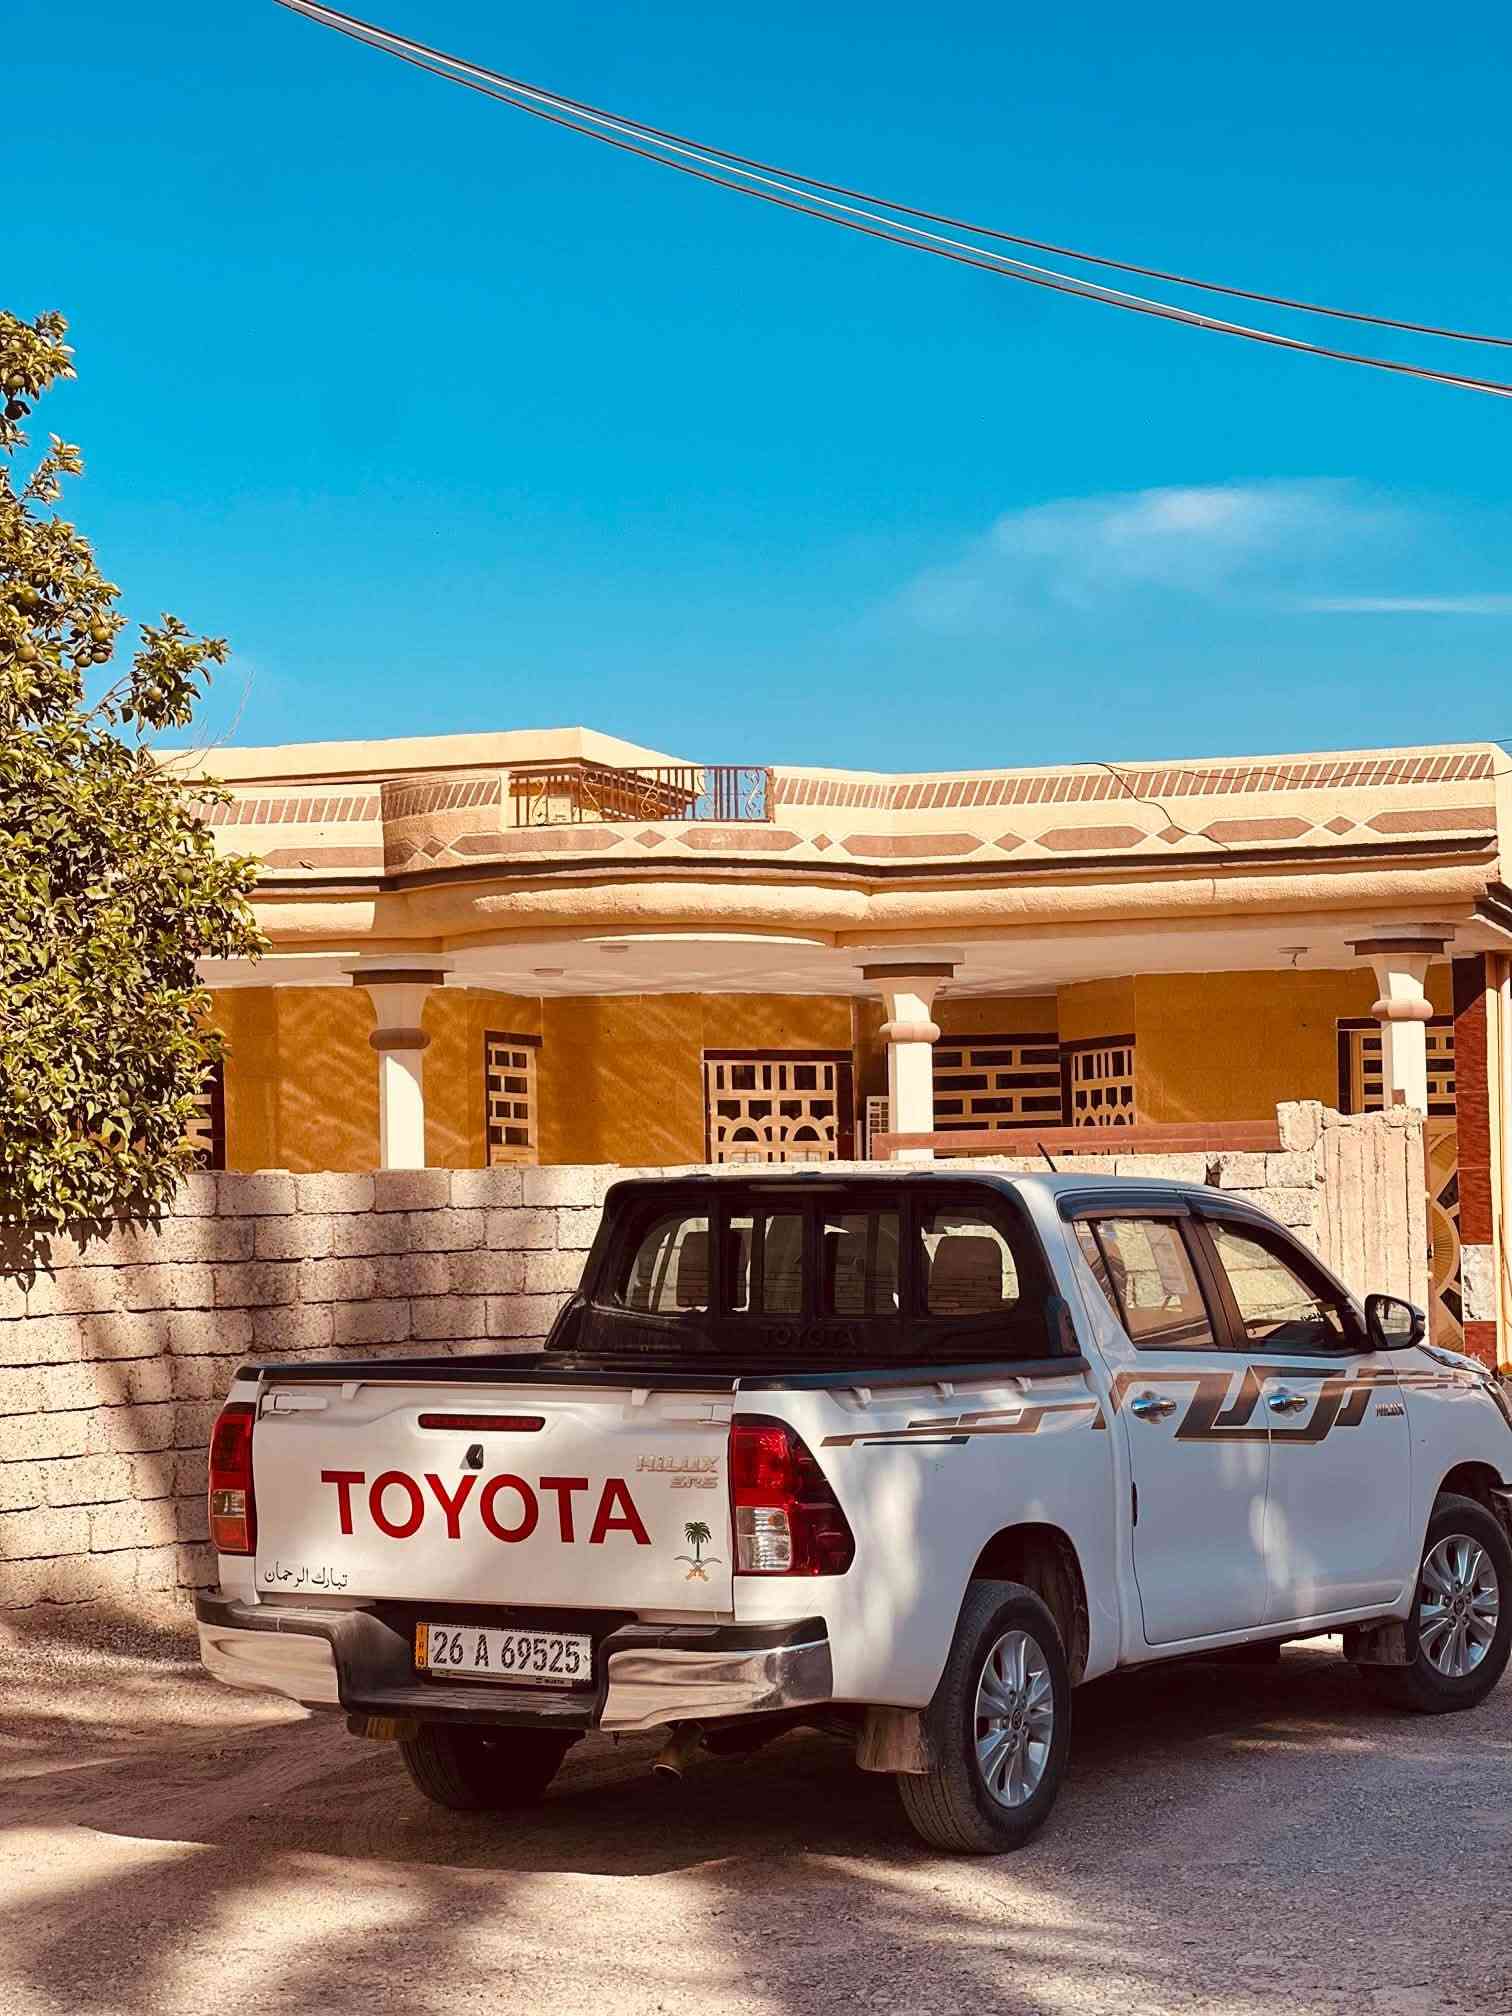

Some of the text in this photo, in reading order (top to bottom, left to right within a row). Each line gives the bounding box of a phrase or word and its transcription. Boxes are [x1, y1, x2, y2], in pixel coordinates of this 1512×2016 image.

[321, 1470, 652, 1545] TOYOTA
[311, 1566, 348, 1590] تبارك
[433, 1631, 580, 1674] 26 A 69525
